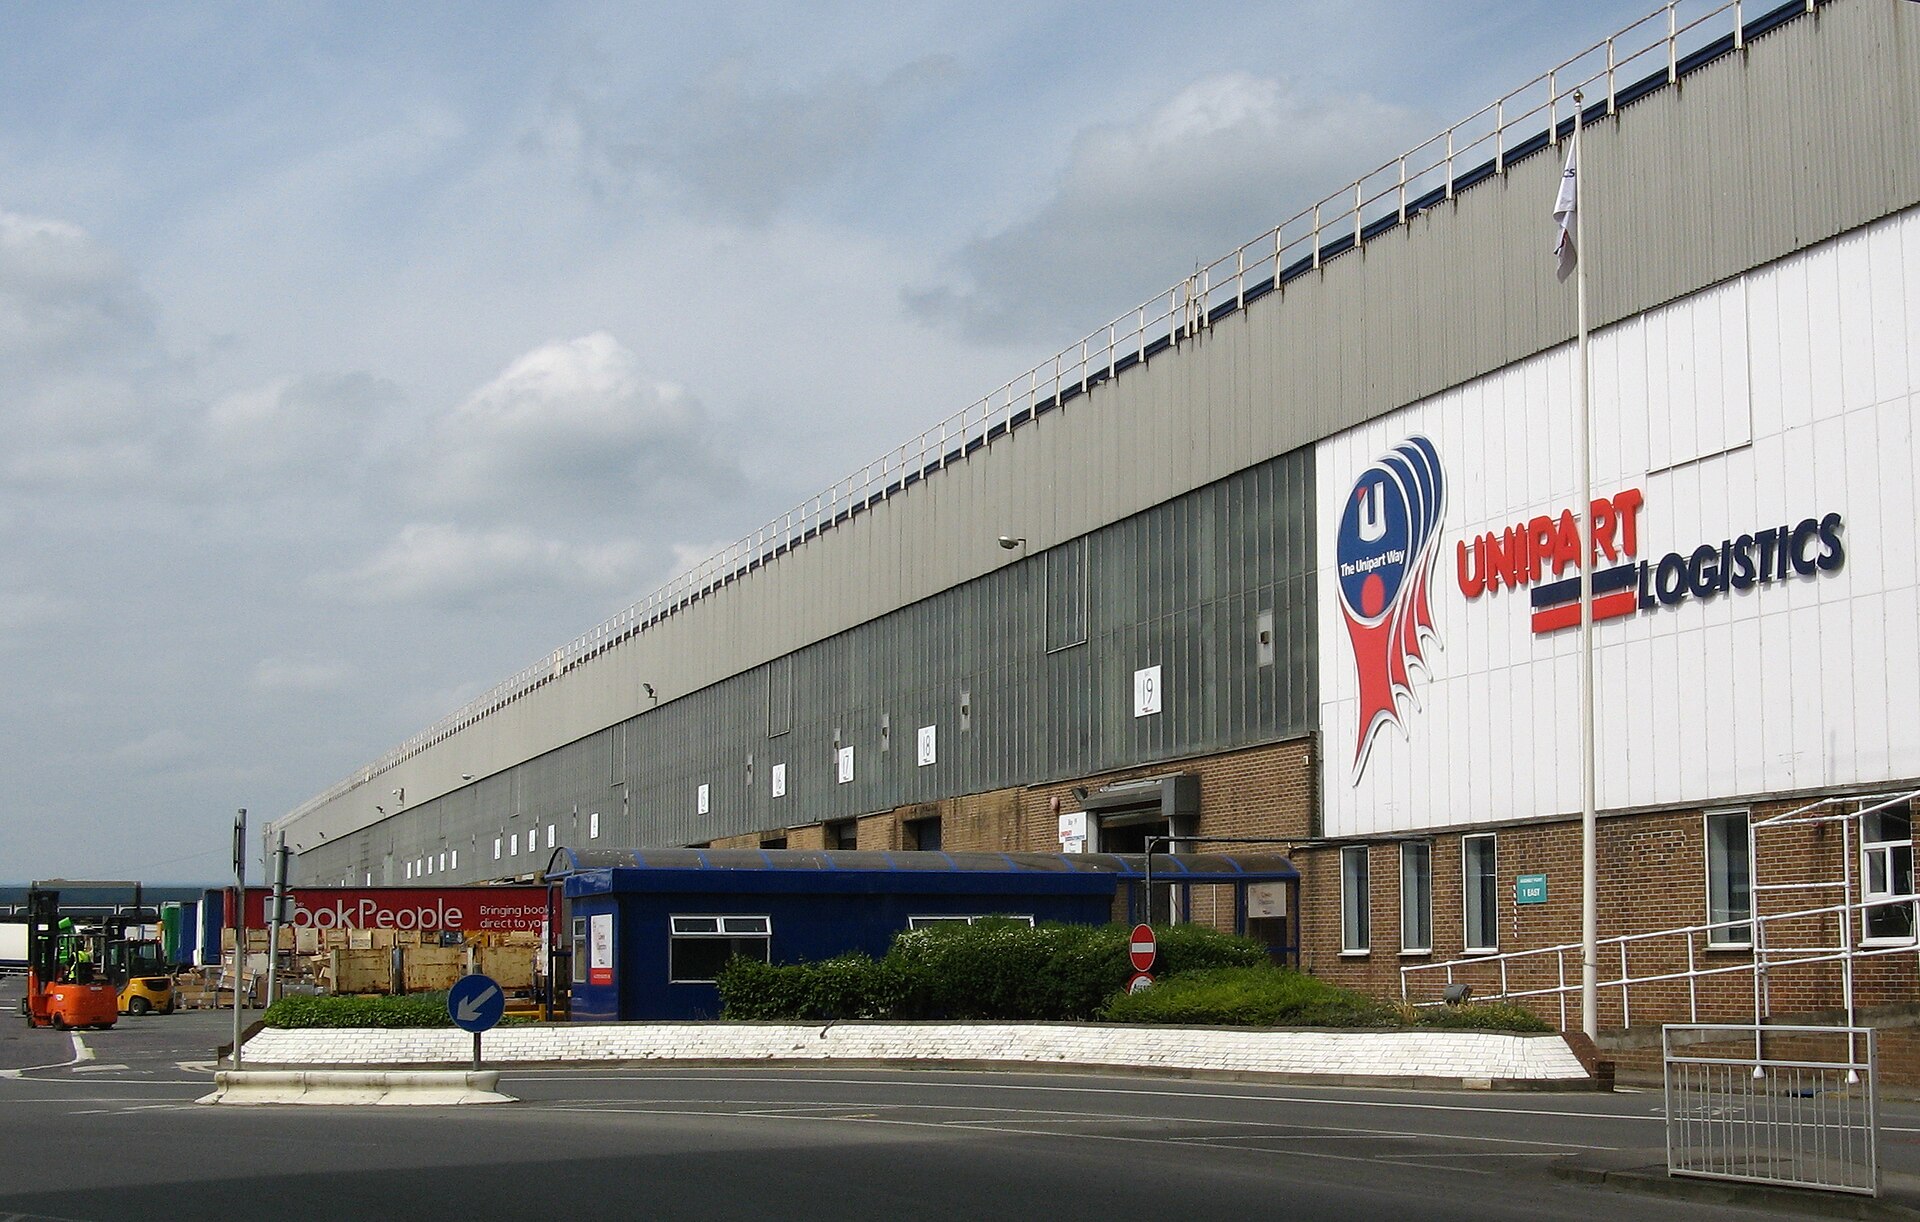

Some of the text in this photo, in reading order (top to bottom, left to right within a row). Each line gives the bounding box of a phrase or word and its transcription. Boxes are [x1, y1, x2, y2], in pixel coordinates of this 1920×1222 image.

[1456, 488, 1642, 598] UNIPART
[1341, 549, 1405, 577] The Unipart Way
[1638, 513, 1843, 610] LOGISTICS
[1142, 678, 1154, 705] 19
[923, 735, 931, 756] 18
[268, 898, 463, 930] ookPeople
[480, 905, 522, 917] Bringing
[480, 918, 512, 928] direct
[514, 919, 526, 928] to
